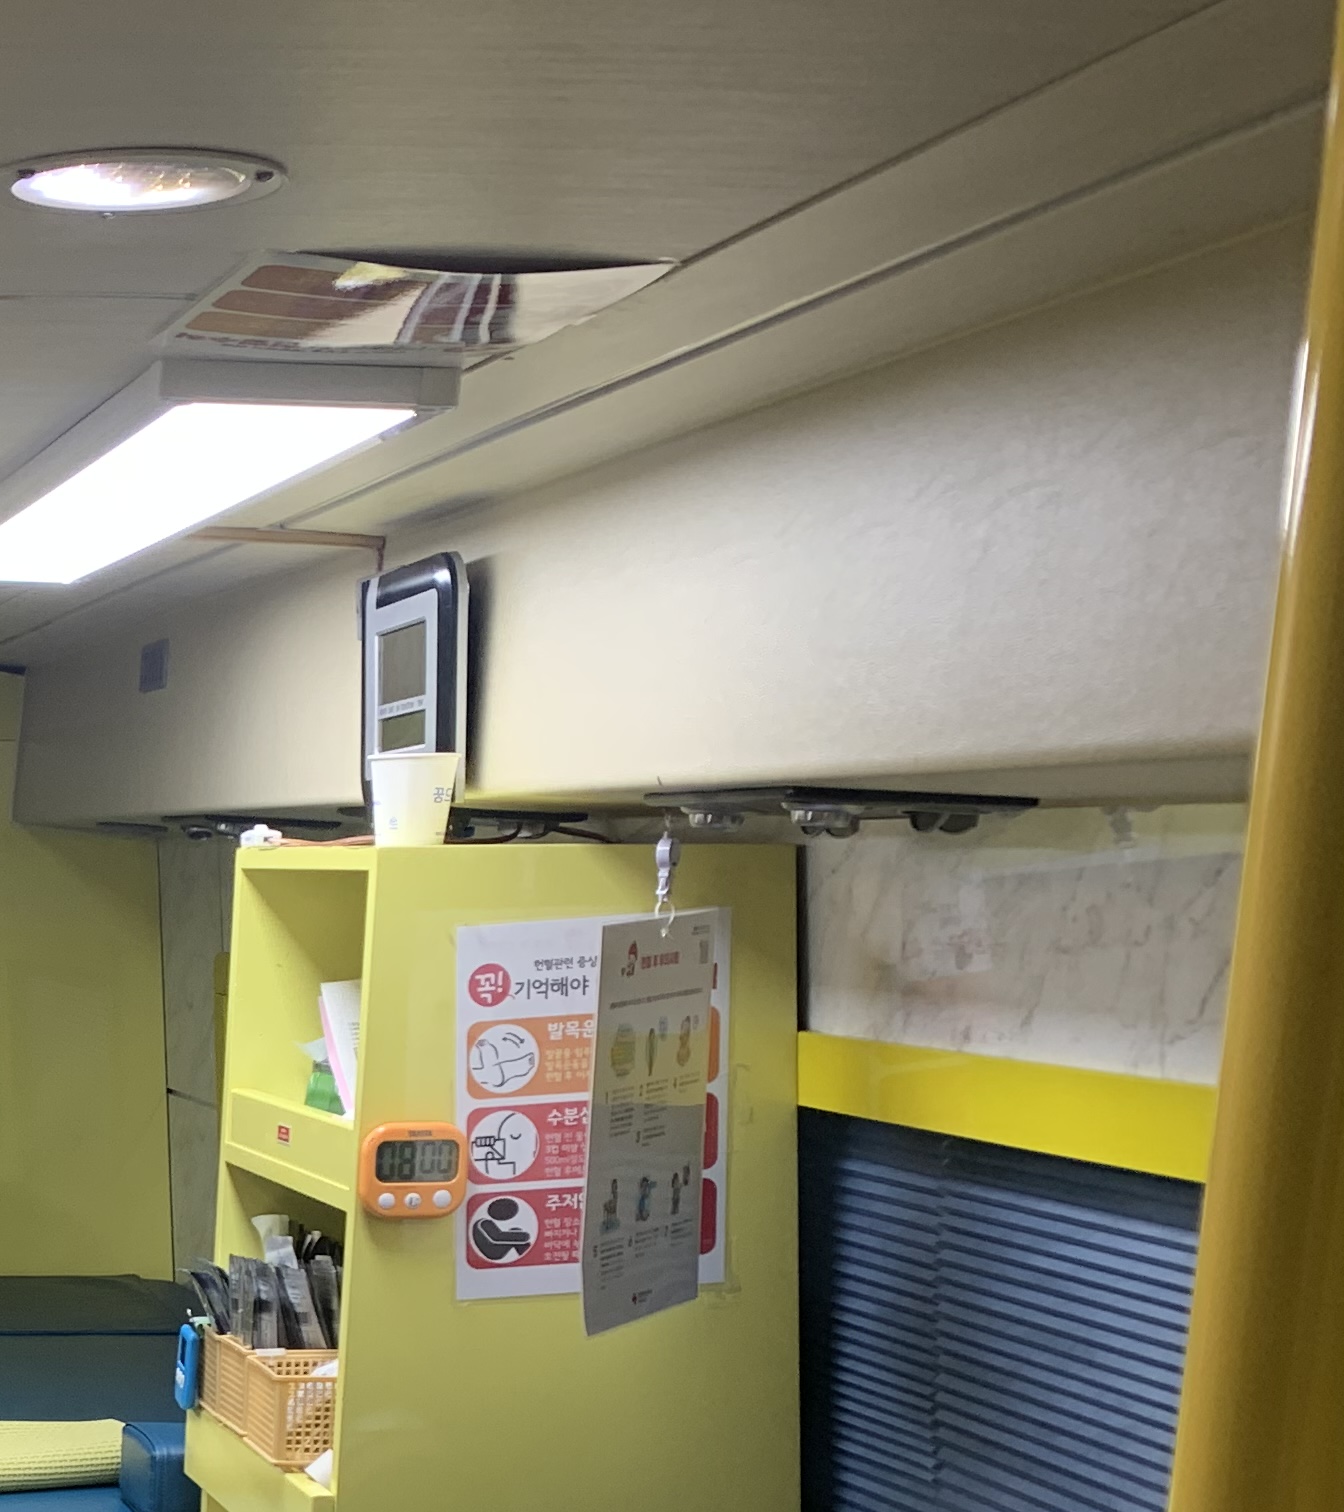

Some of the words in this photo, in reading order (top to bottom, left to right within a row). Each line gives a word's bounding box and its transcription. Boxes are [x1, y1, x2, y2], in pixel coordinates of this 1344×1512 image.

[534, 957, 574, 971] 헌혈관련
[475, 971, 504, 1004] 꼭!
[514, 975, 590, 1000] 기억해야
